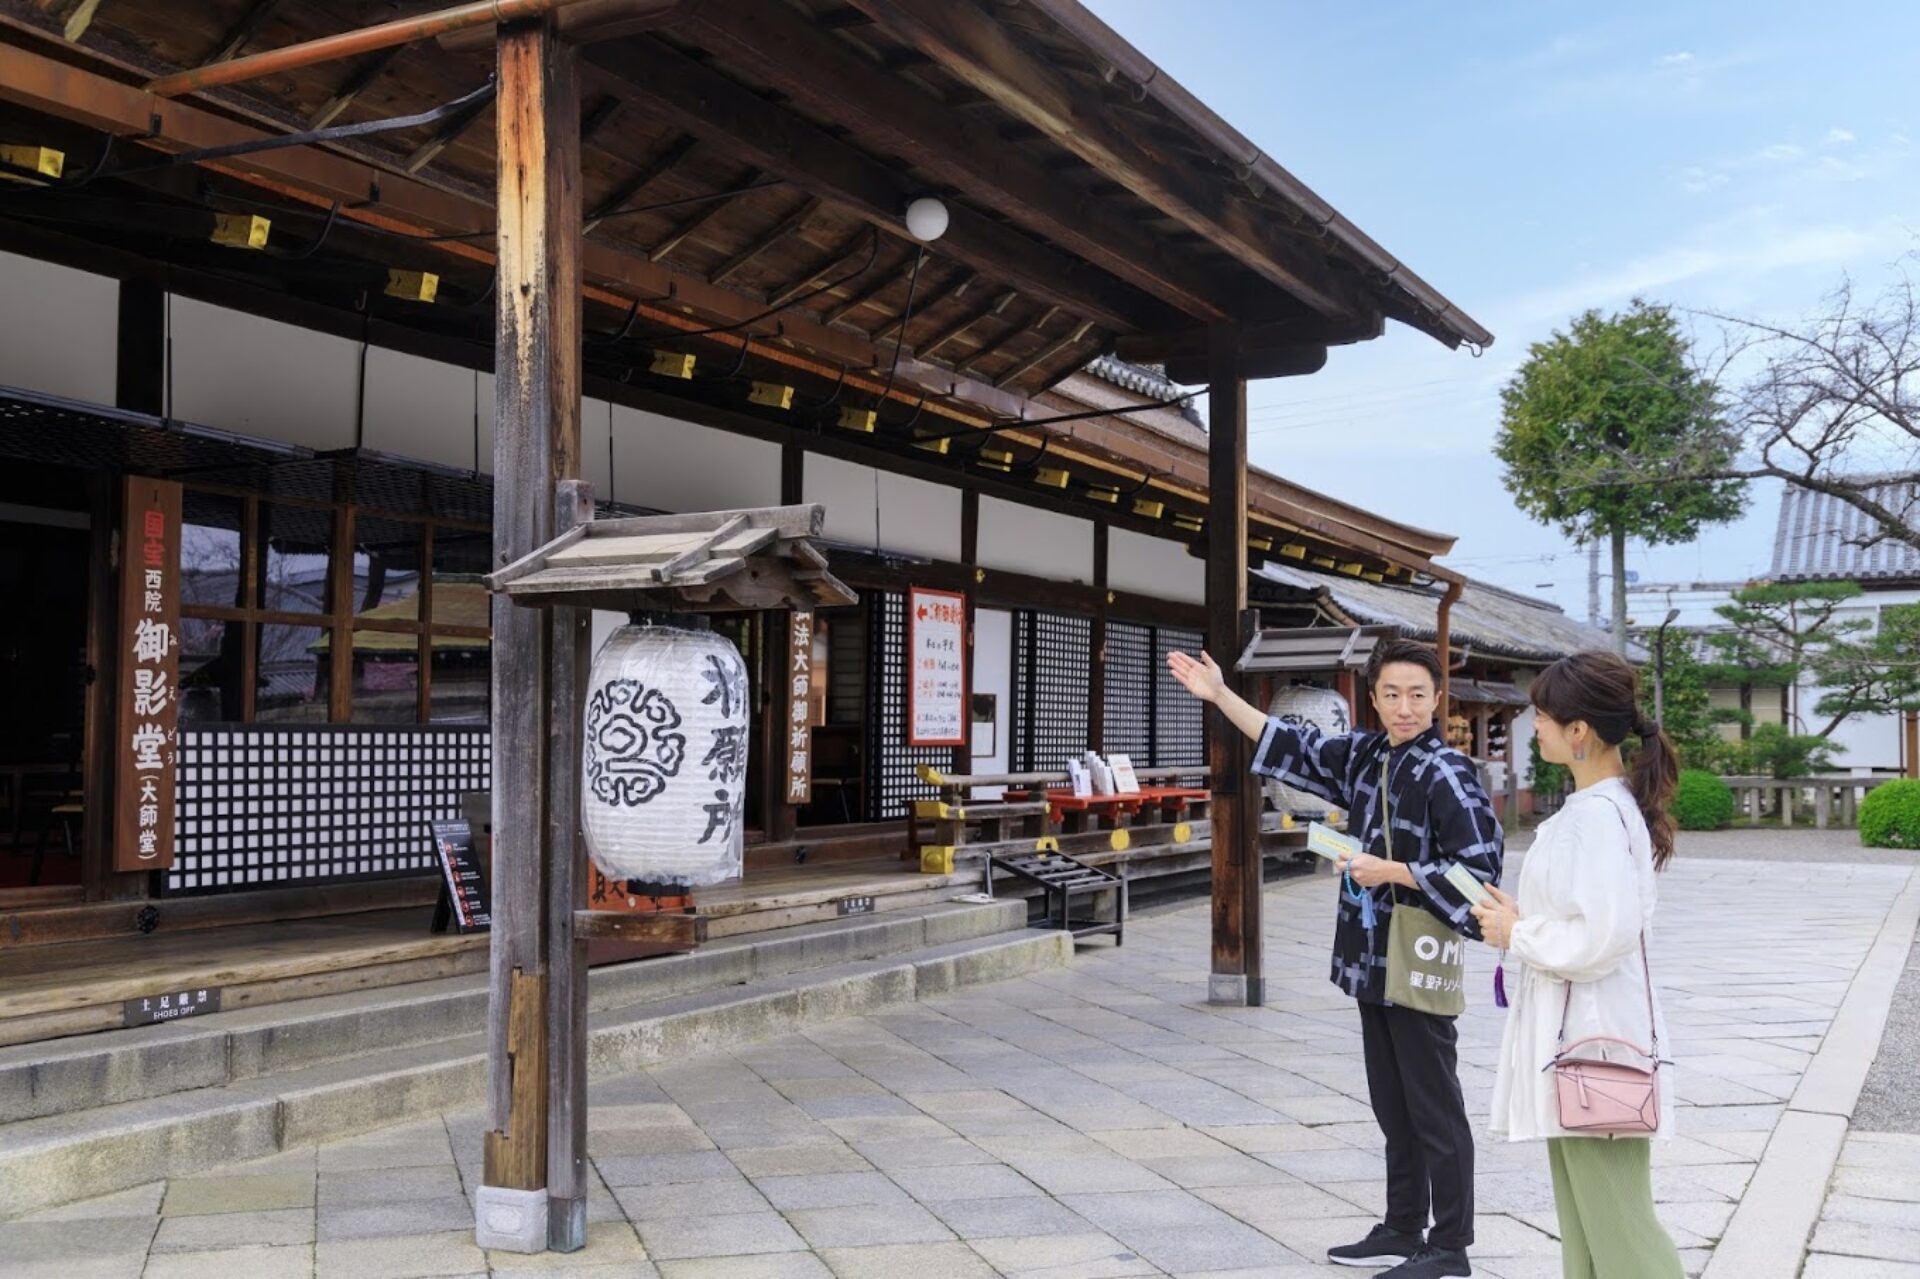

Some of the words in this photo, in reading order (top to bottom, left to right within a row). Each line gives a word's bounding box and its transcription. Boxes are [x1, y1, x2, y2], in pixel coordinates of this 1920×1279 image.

[144, 569, 162, 613] 西院
[132, 618, 170, 770] 御影堂
